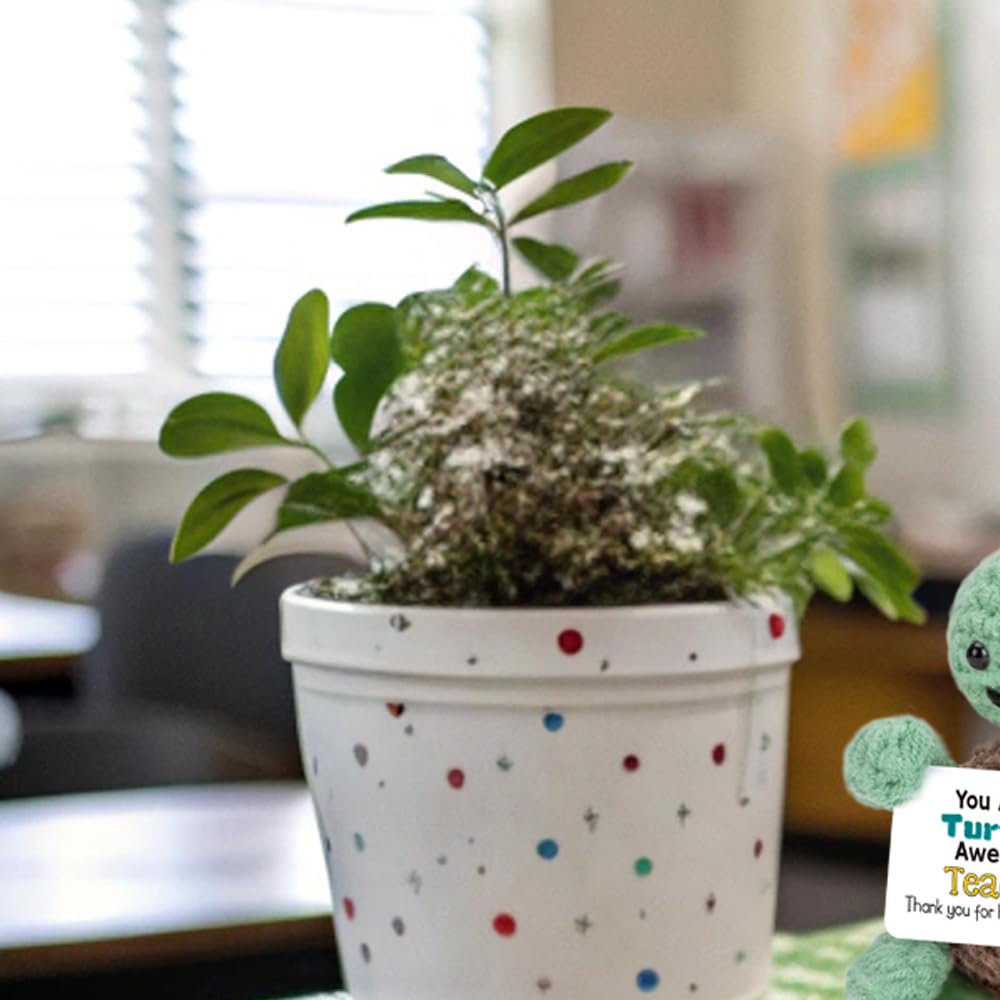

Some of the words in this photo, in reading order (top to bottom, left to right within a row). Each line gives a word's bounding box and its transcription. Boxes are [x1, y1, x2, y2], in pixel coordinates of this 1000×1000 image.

[955, 789, 990, 810] You
[905, 895, 943, 914] Thank
[946, 904, 970, 918] you
[974, 904, 995, 921] for
